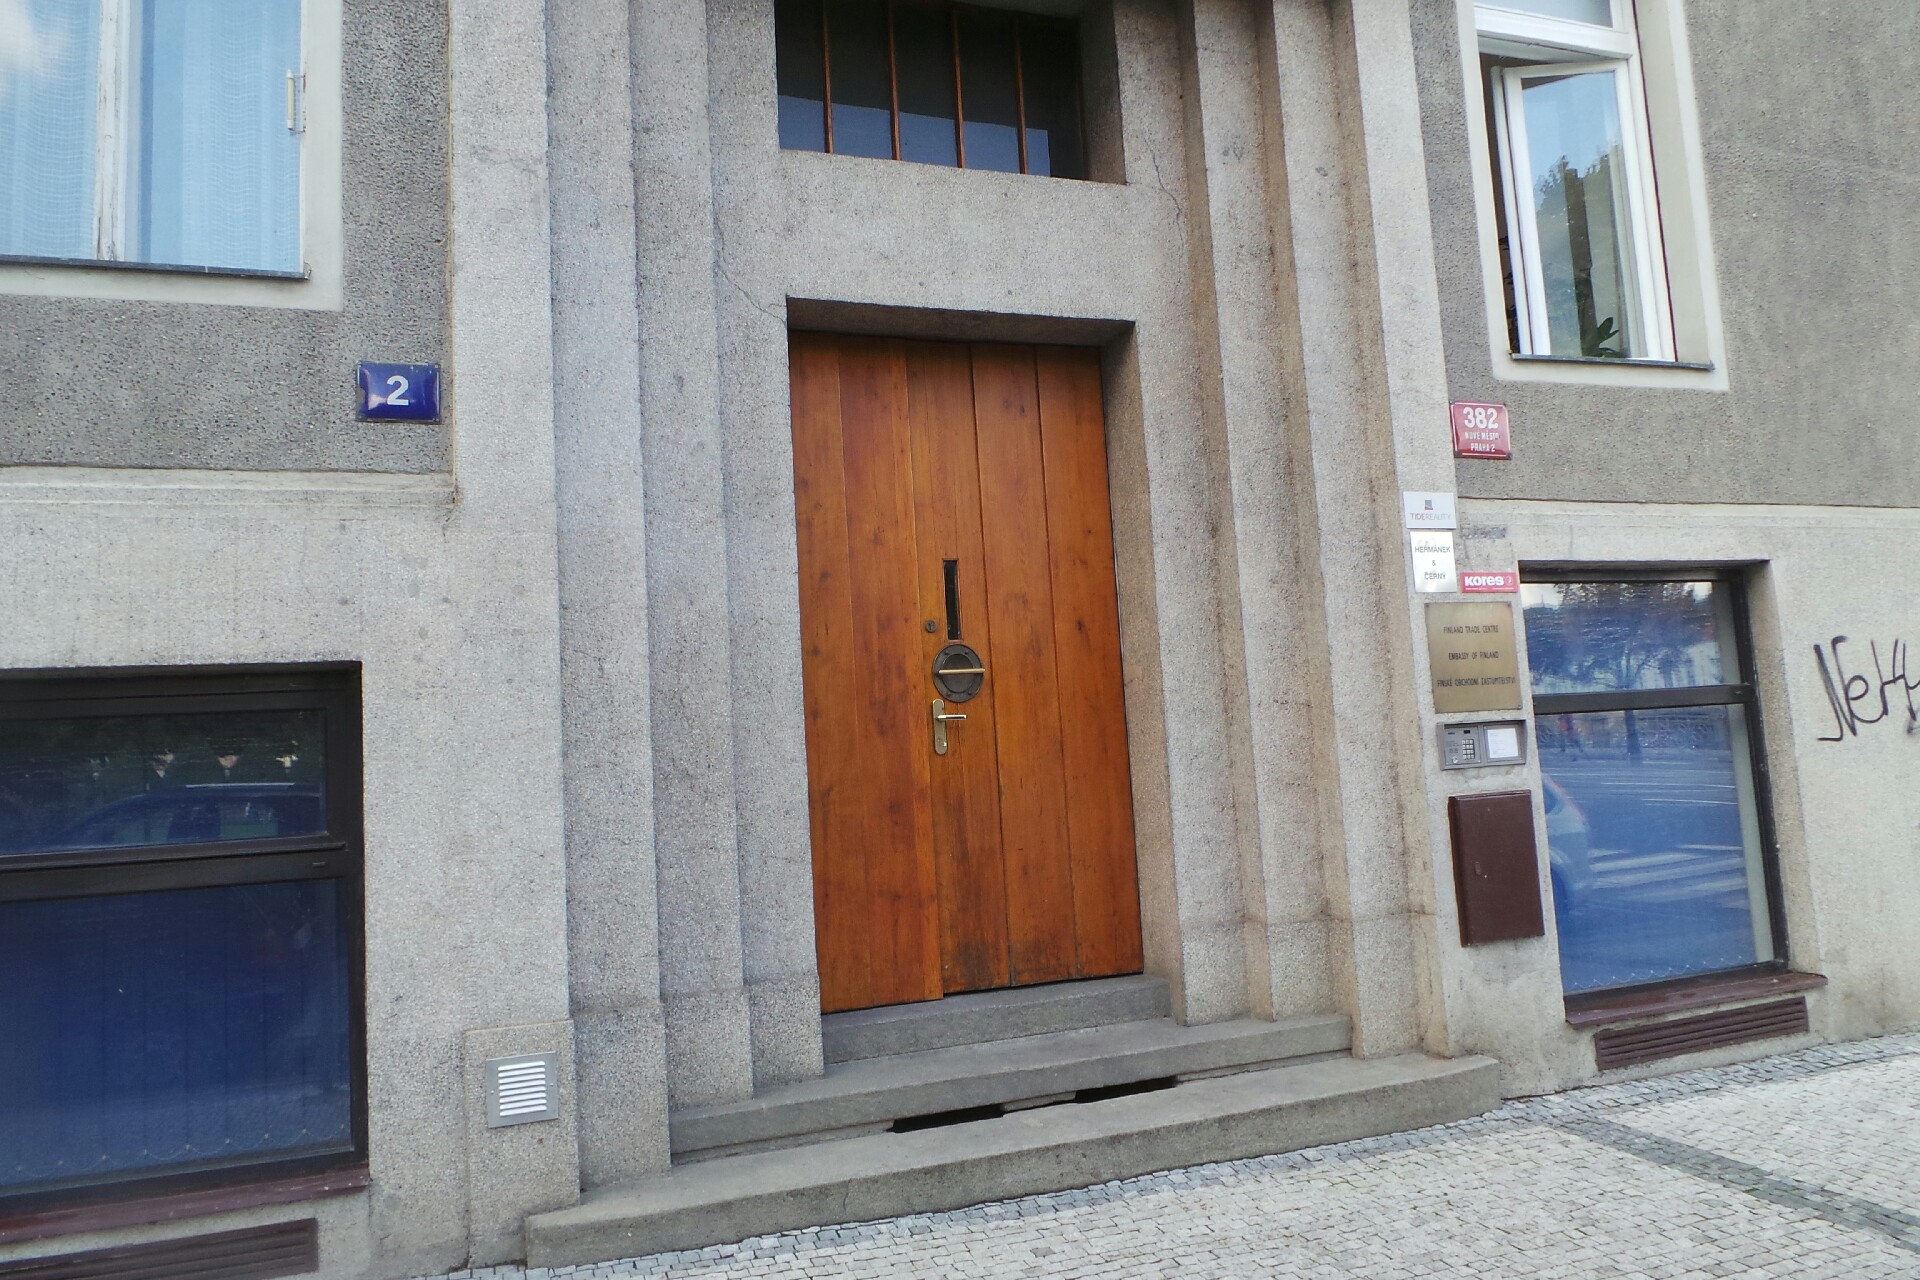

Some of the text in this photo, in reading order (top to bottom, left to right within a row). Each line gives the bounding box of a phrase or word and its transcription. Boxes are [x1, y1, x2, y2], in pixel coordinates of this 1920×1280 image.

[387, 375, 409, 406] 2
[1463, 406, 1499, 429] 382
[1464, 430, 1481, 440] NOVÉ
[1471, 442, 1496, 452] PRAHA 2
[1432, 559, 1436, 567] &
[1443, 624, 1499, 634] FINLAND TRADE CENTRE
[1448, 650, 1499, 661] EMBASSY OF FINLAND
